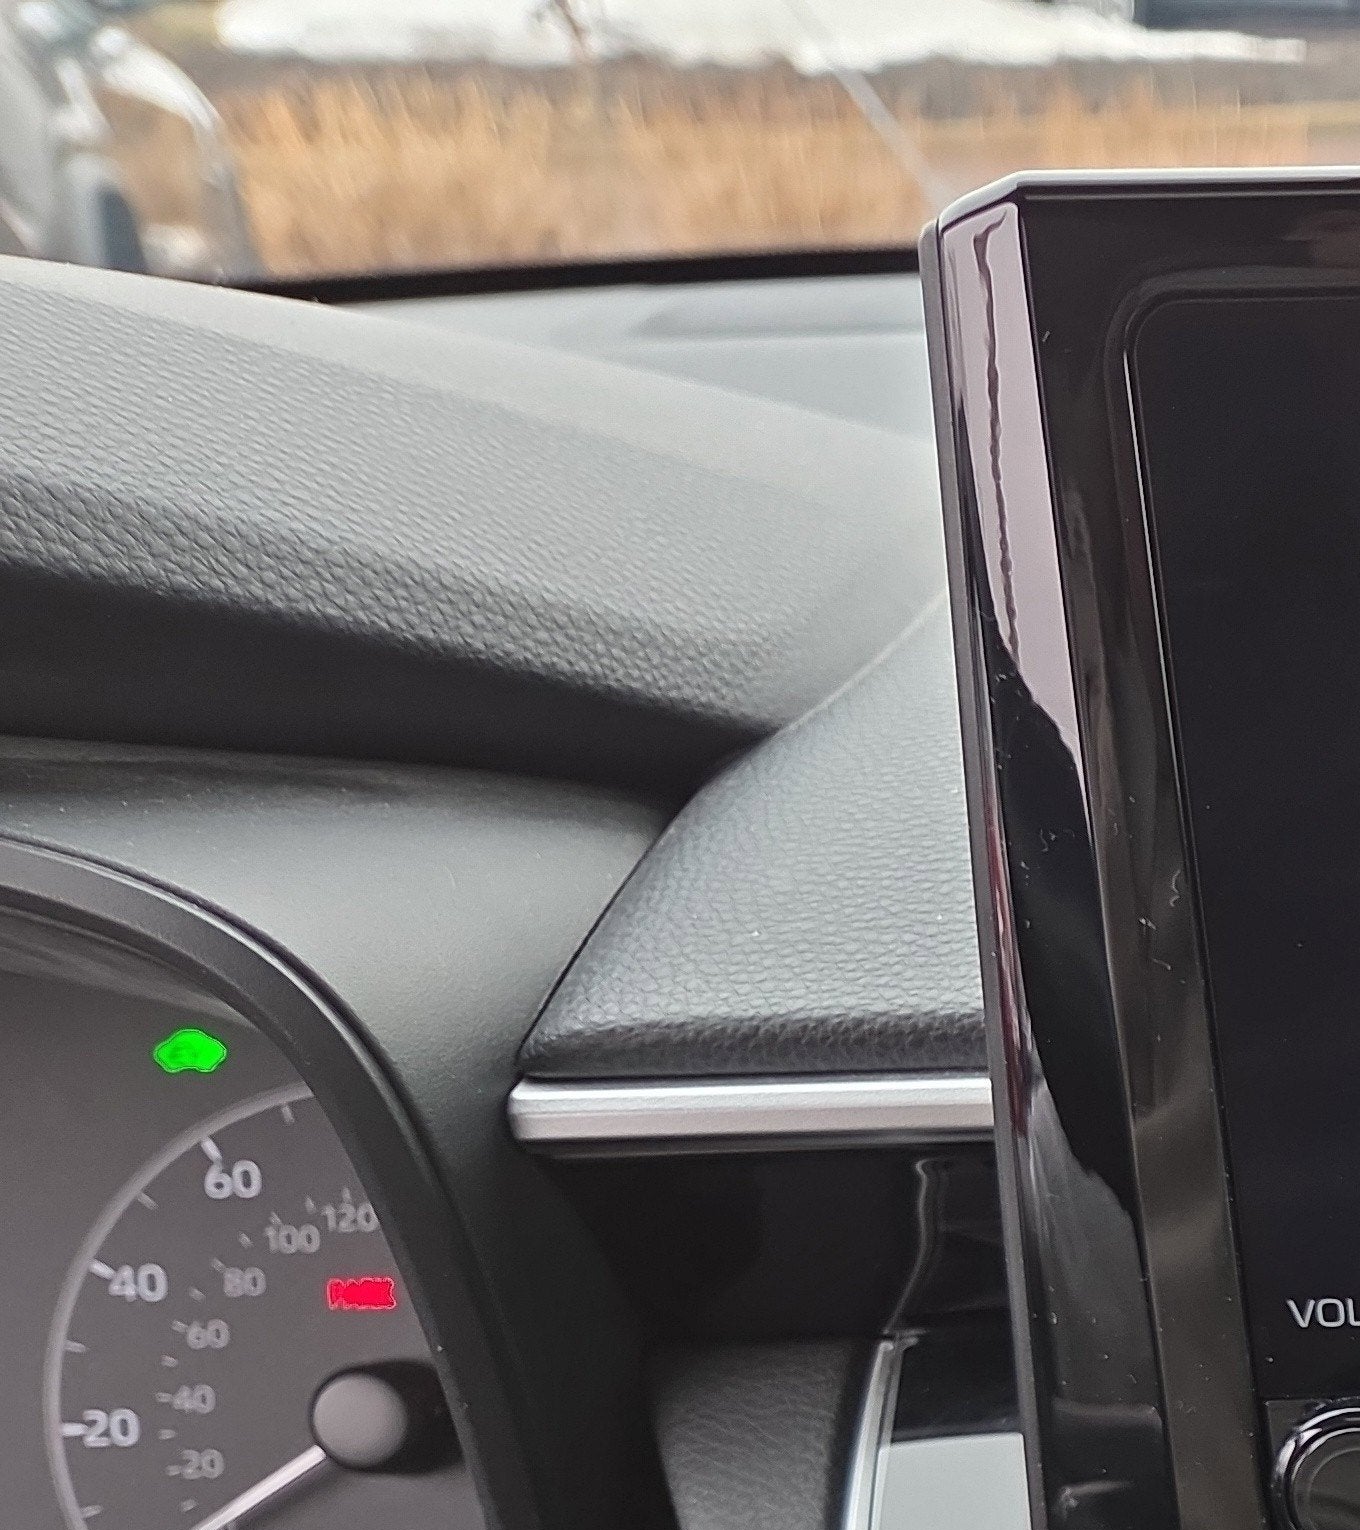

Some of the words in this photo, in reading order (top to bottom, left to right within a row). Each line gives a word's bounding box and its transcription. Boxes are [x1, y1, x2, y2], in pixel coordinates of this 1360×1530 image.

[203, 1160, 262, 1199] 60
[321, 1203, 381, 1233] 120
[265, 1225, 320, 1255] 100
[108, 1263, 167, 1303] 40
[223, 1268, 266, 1298] 80
[186, 1319, 230, 1350] 60
[173, 1384, 216, 1414] 40
[83, 1409, 140, 1447] 20
[179, 1449, 224, 1479] 20
